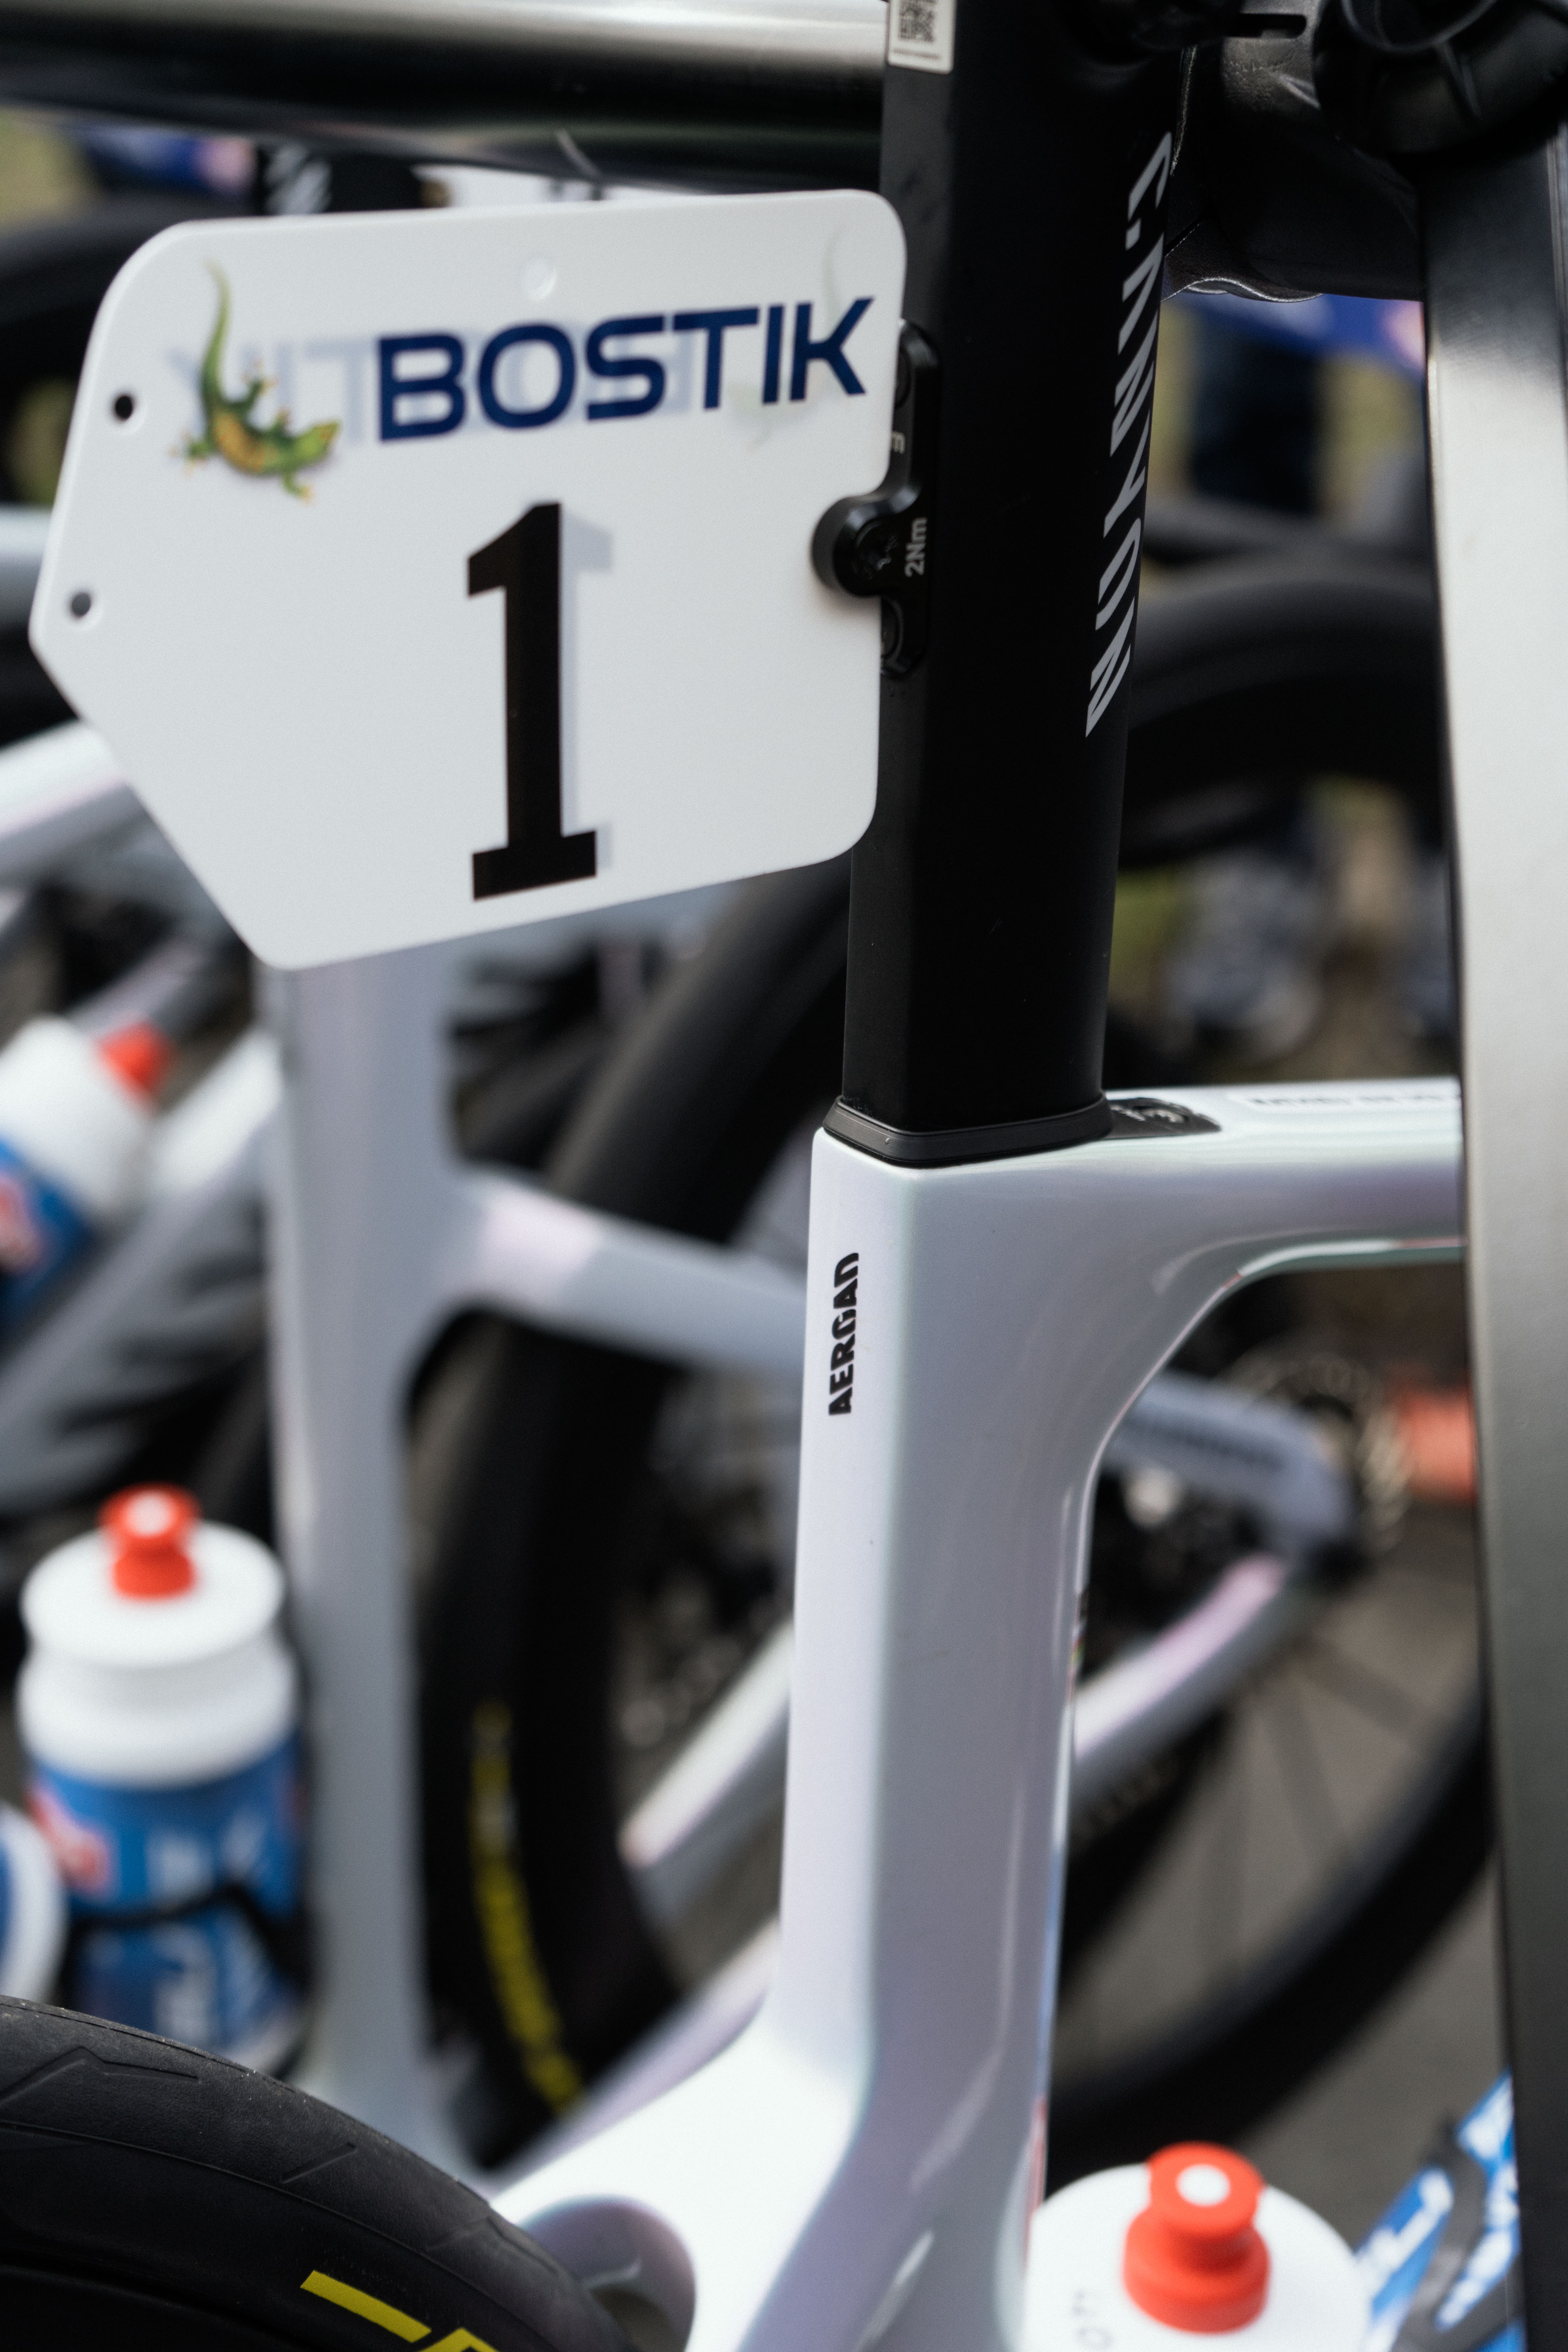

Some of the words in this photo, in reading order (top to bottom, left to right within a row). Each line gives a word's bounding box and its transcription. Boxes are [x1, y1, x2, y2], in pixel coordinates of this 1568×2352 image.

[377, 296, 874, 443] BOSTIK
[904, 516, 928, 577] 2Nm
[466, 501, 597, 901] 1
